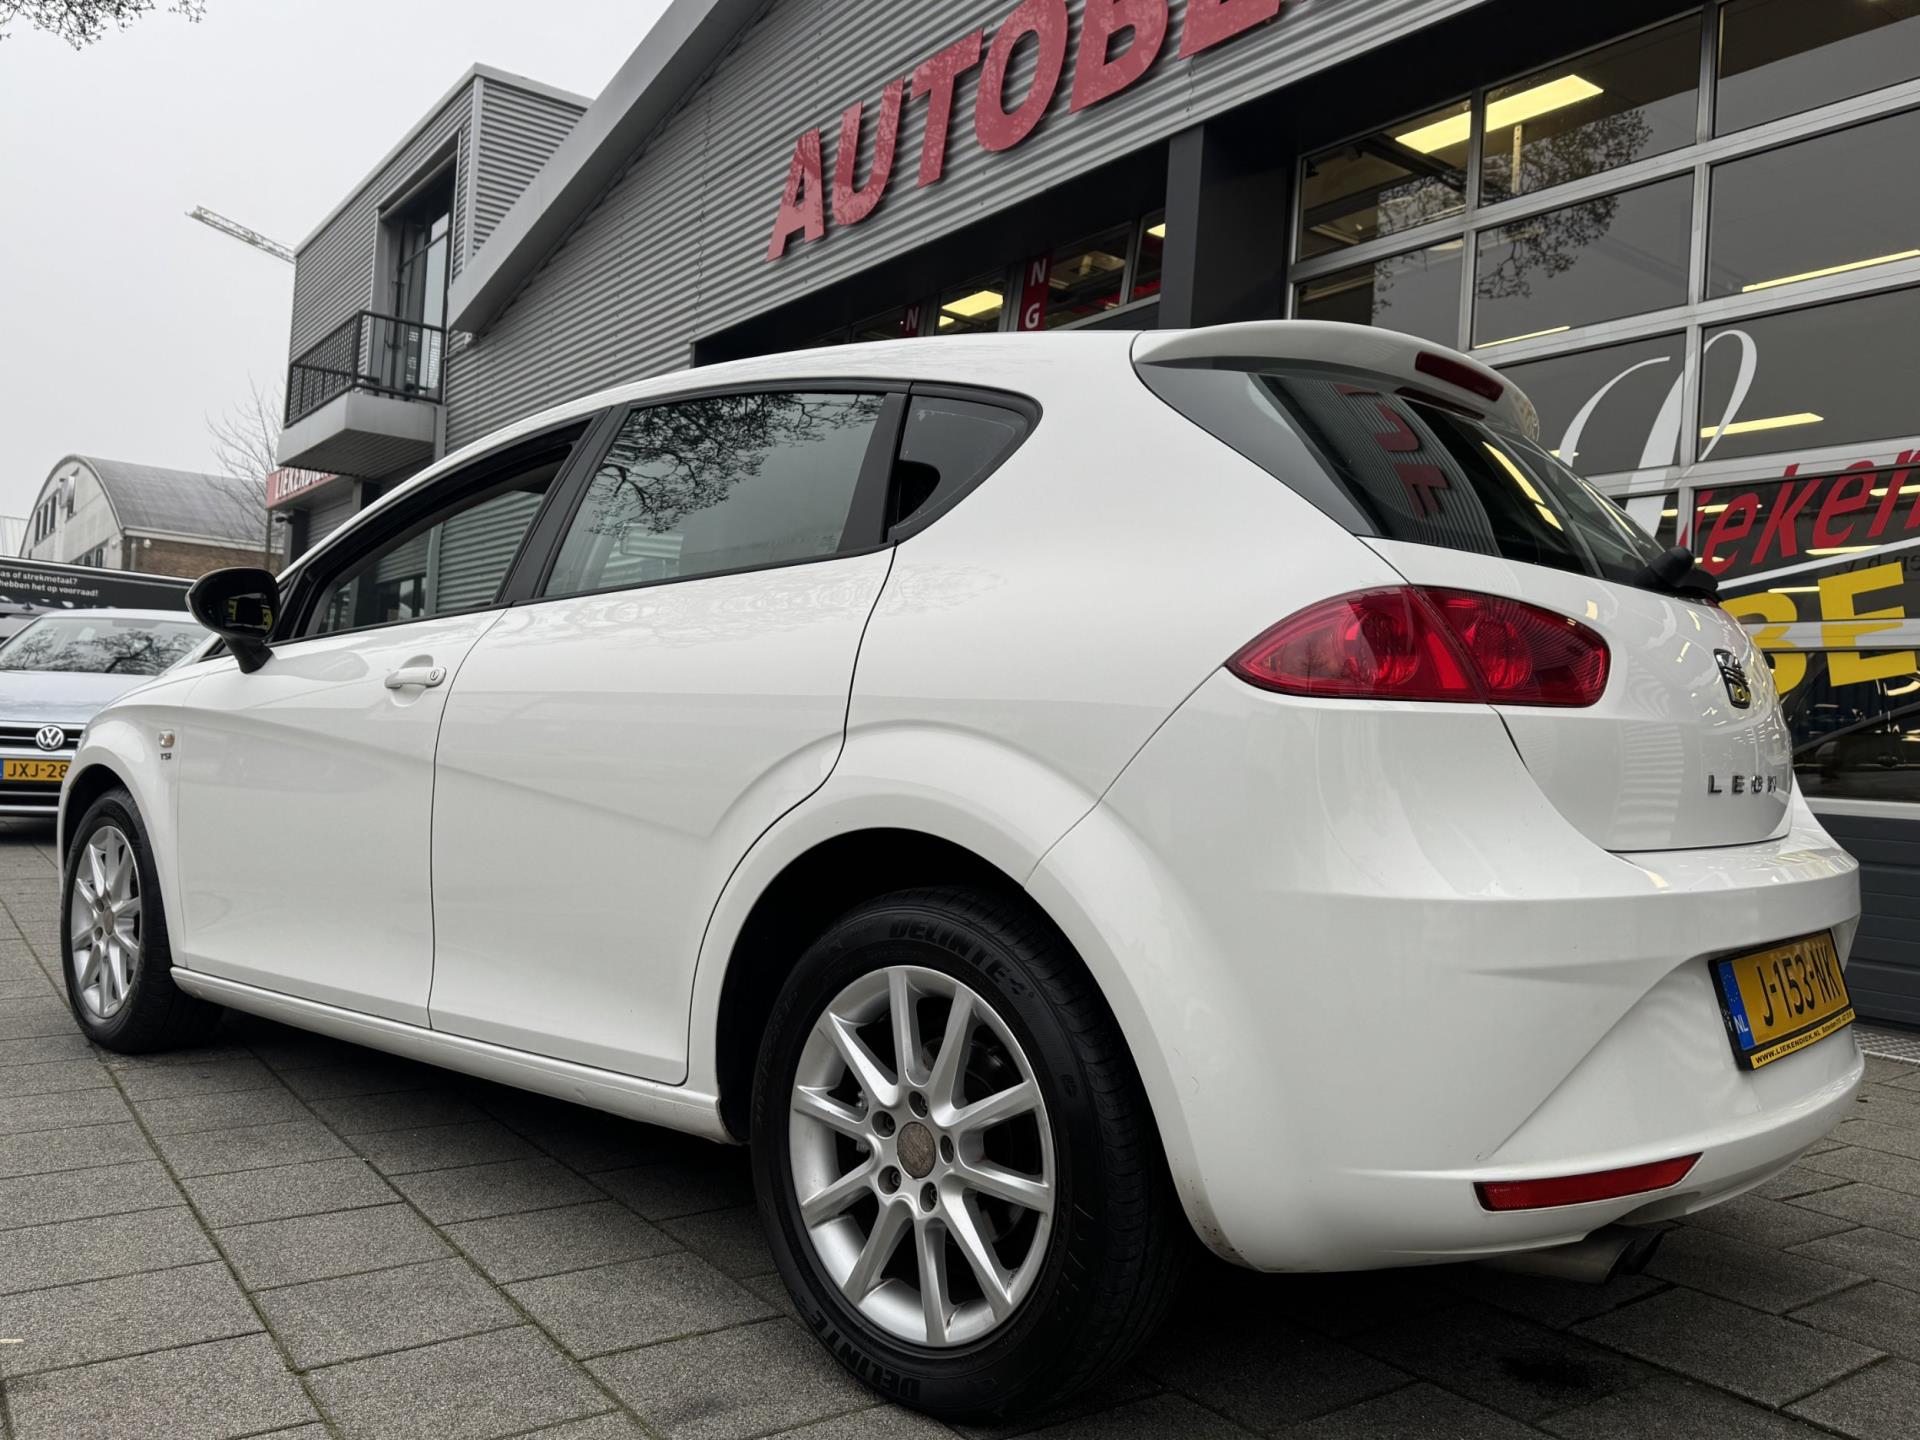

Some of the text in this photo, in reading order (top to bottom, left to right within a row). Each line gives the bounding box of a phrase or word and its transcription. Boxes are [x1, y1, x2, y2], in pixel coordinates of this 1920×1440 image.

[31, 582, 46, 591] het
[46, 585, 58, 593] op
[59, 586, 98, 597] voorraad!
[1708, 774, 1777, 794] LEON
[1756, 943, 1841, 1027] J-153-NK
[1733, 1013, 1749, 1035] NL
